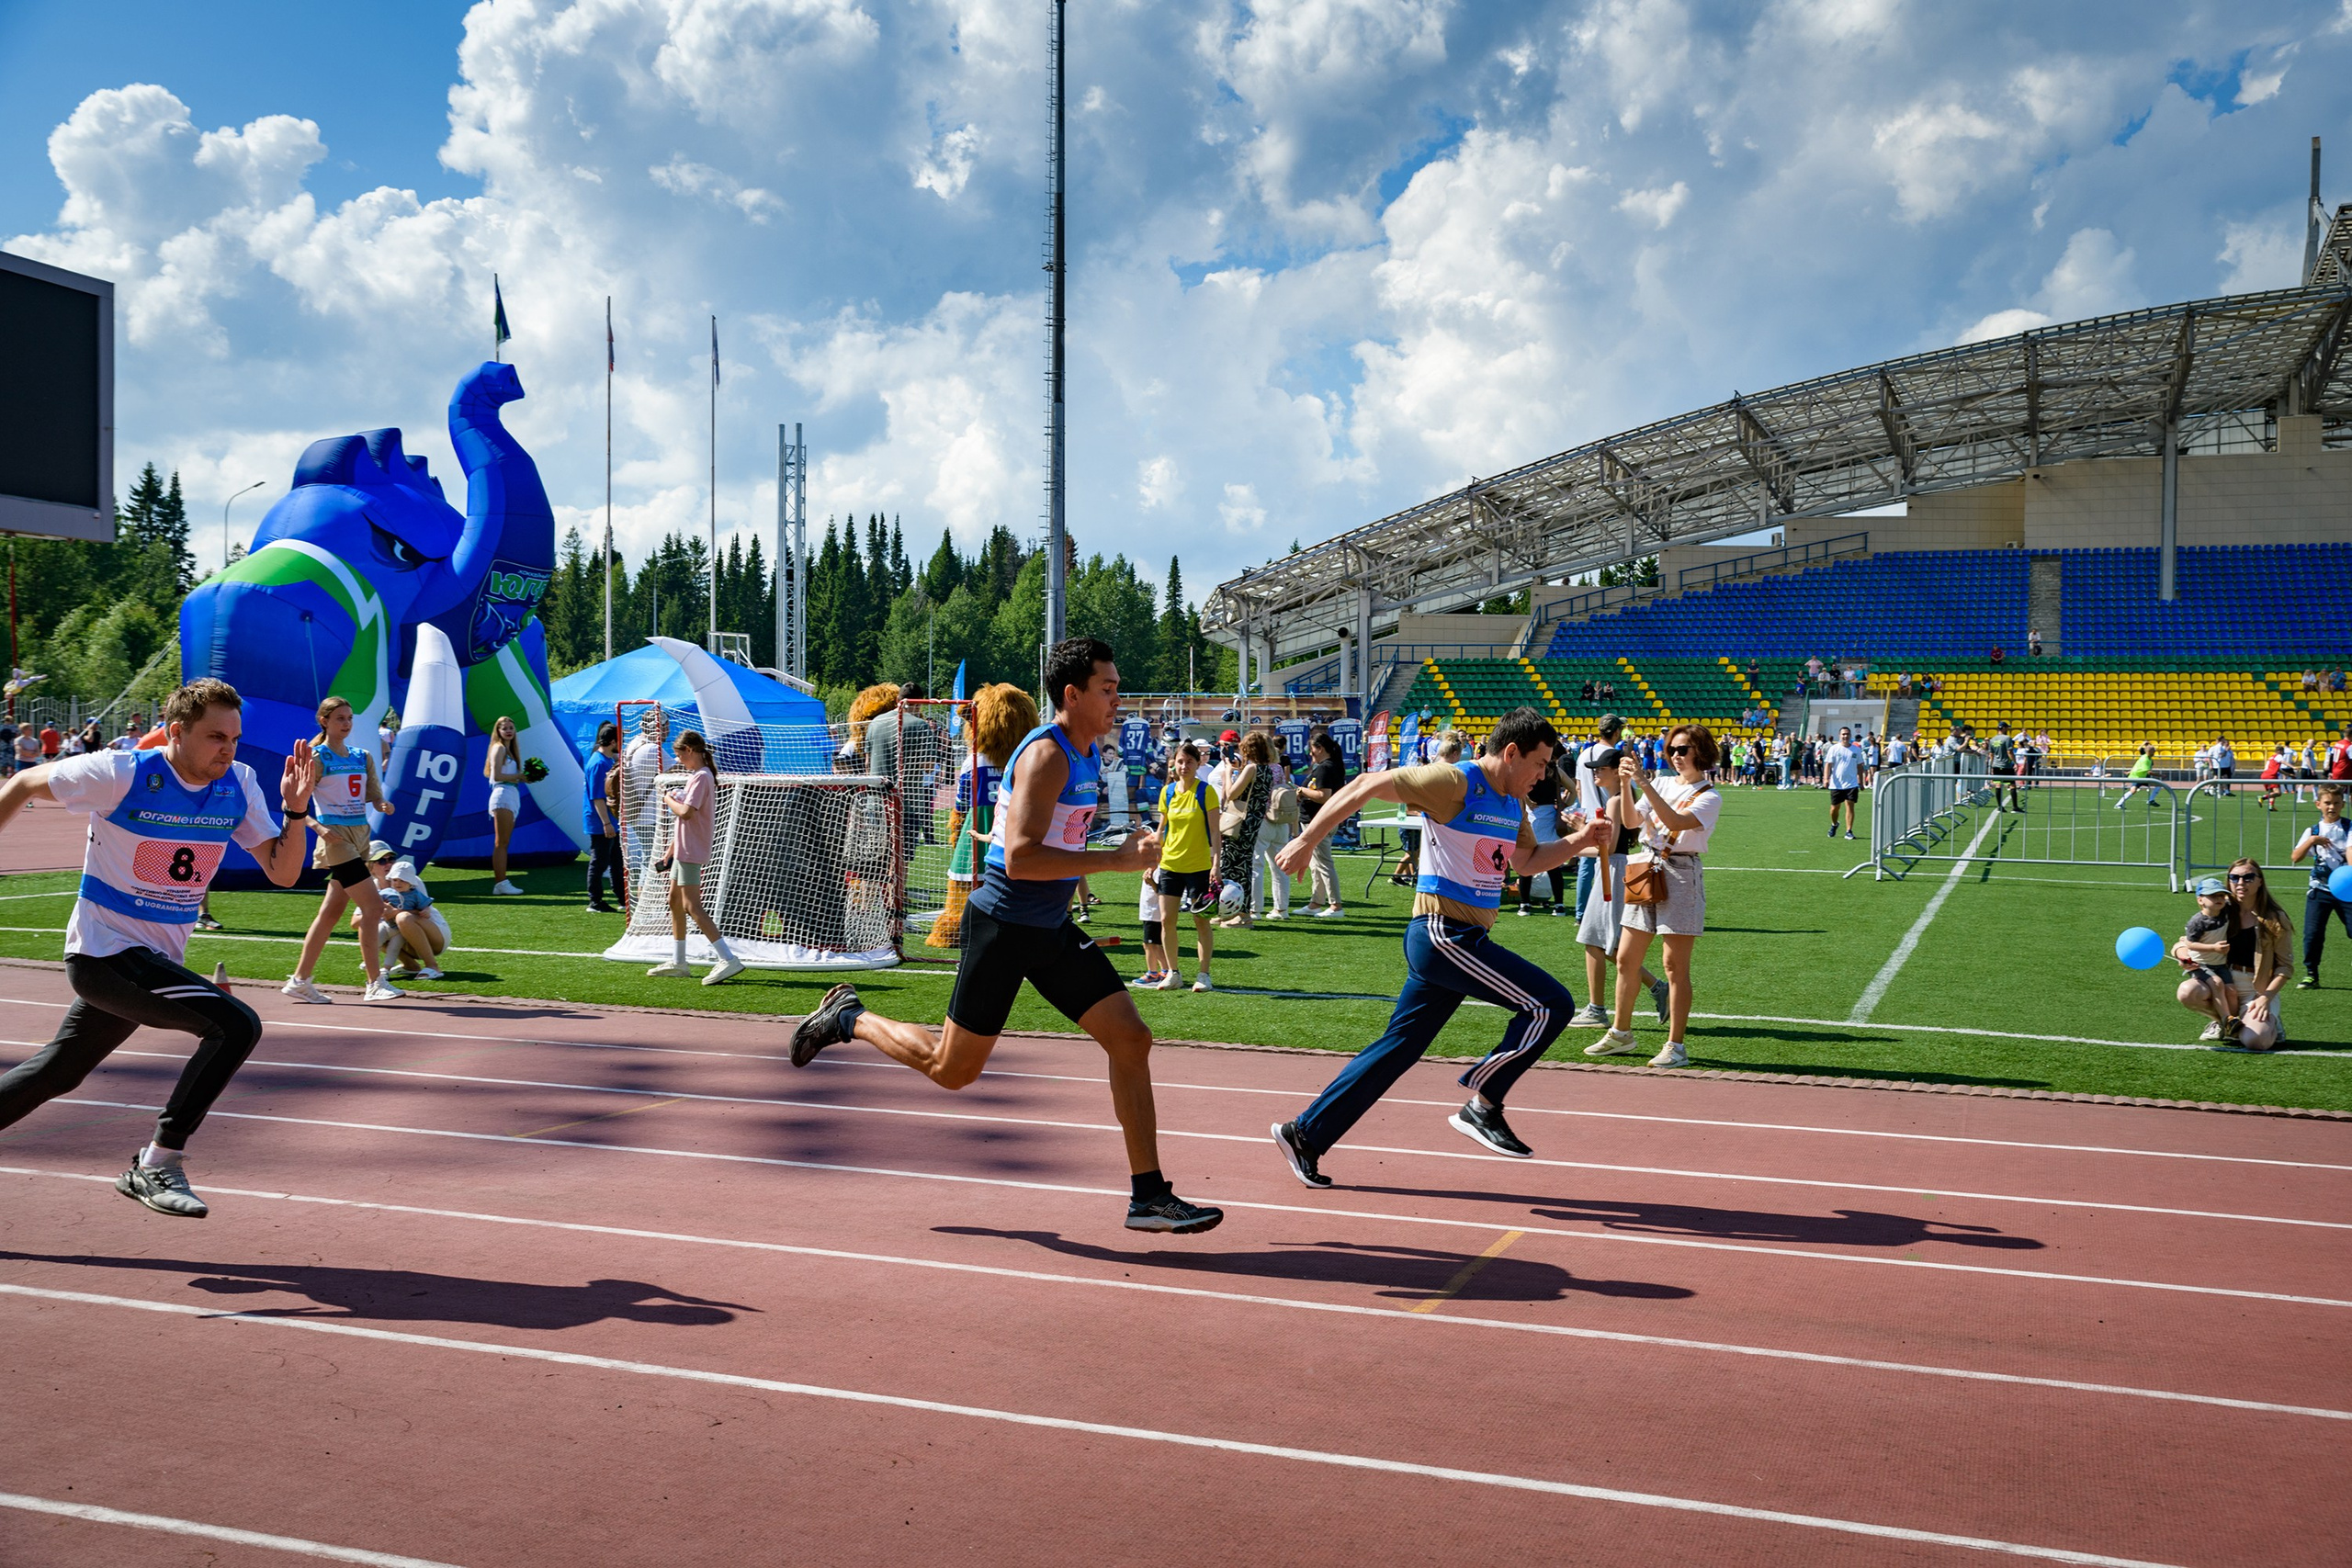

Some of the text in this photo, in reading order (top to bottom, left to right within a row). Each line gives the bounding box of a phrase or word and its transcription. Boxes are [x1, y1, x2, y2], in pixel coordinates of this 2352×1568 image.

[1126, 730, 1145, 750] 37
[1286, 733, 1303, 754] 19
[1333, 733, 1356, 754] 70
[348, 774, 362, 797] 6
[168, 847, 195, 882] 8
